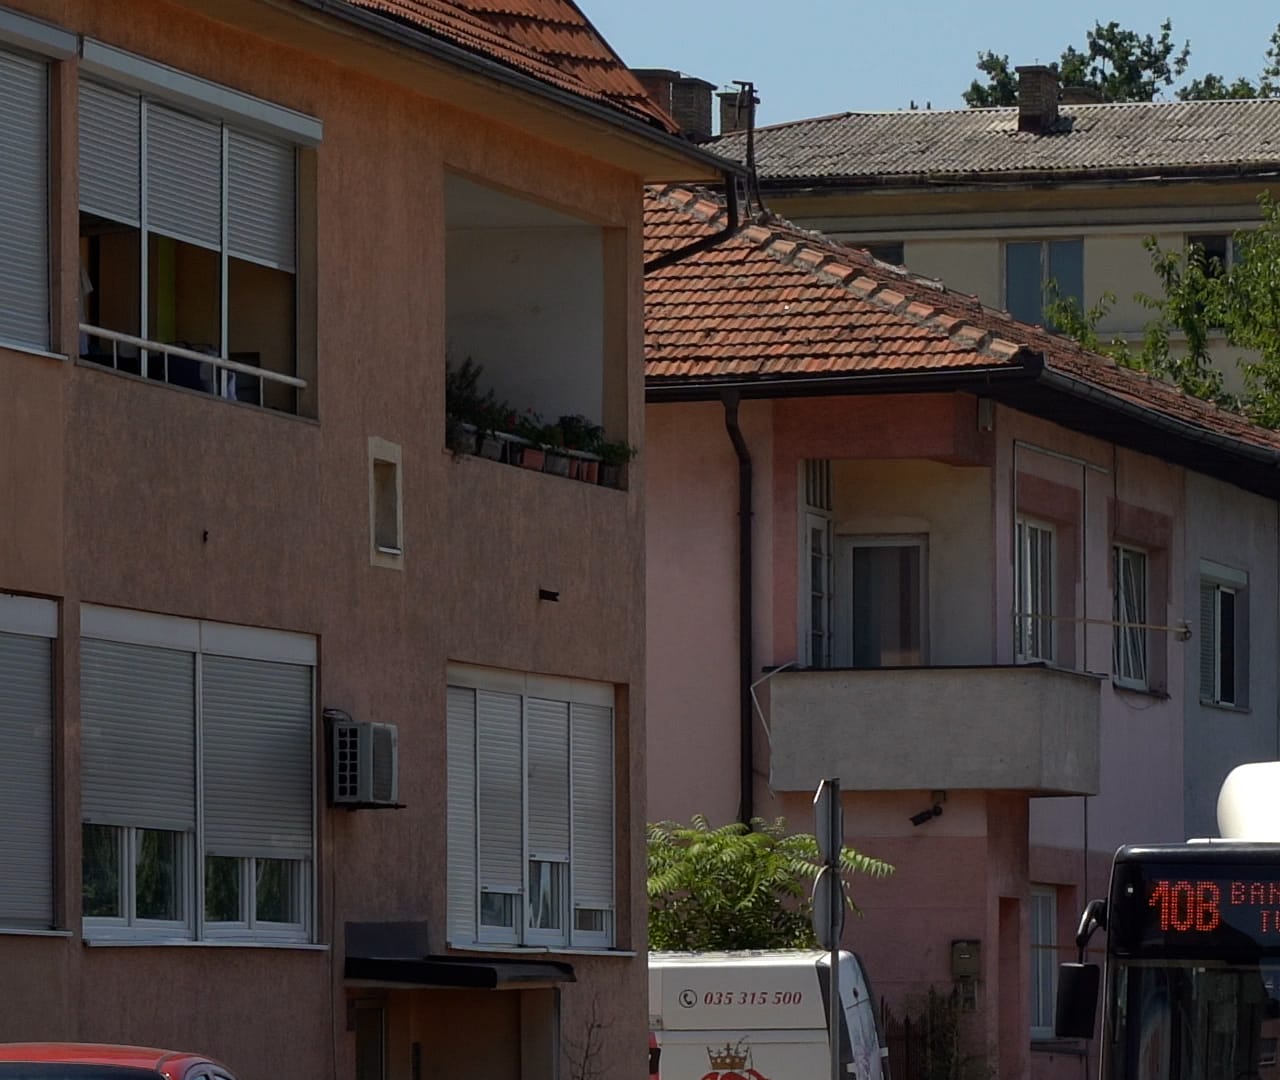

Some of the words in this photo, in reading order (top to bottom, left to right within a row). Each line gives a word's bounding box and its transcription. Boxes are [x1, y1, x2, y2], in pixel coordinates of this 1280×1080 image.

[1149, 881, 1220, 931] 10B
[703, 991, 734, 1005] 035
[738, 991, 768, 1005] 315
[772, 991, 802, 1005] 500
